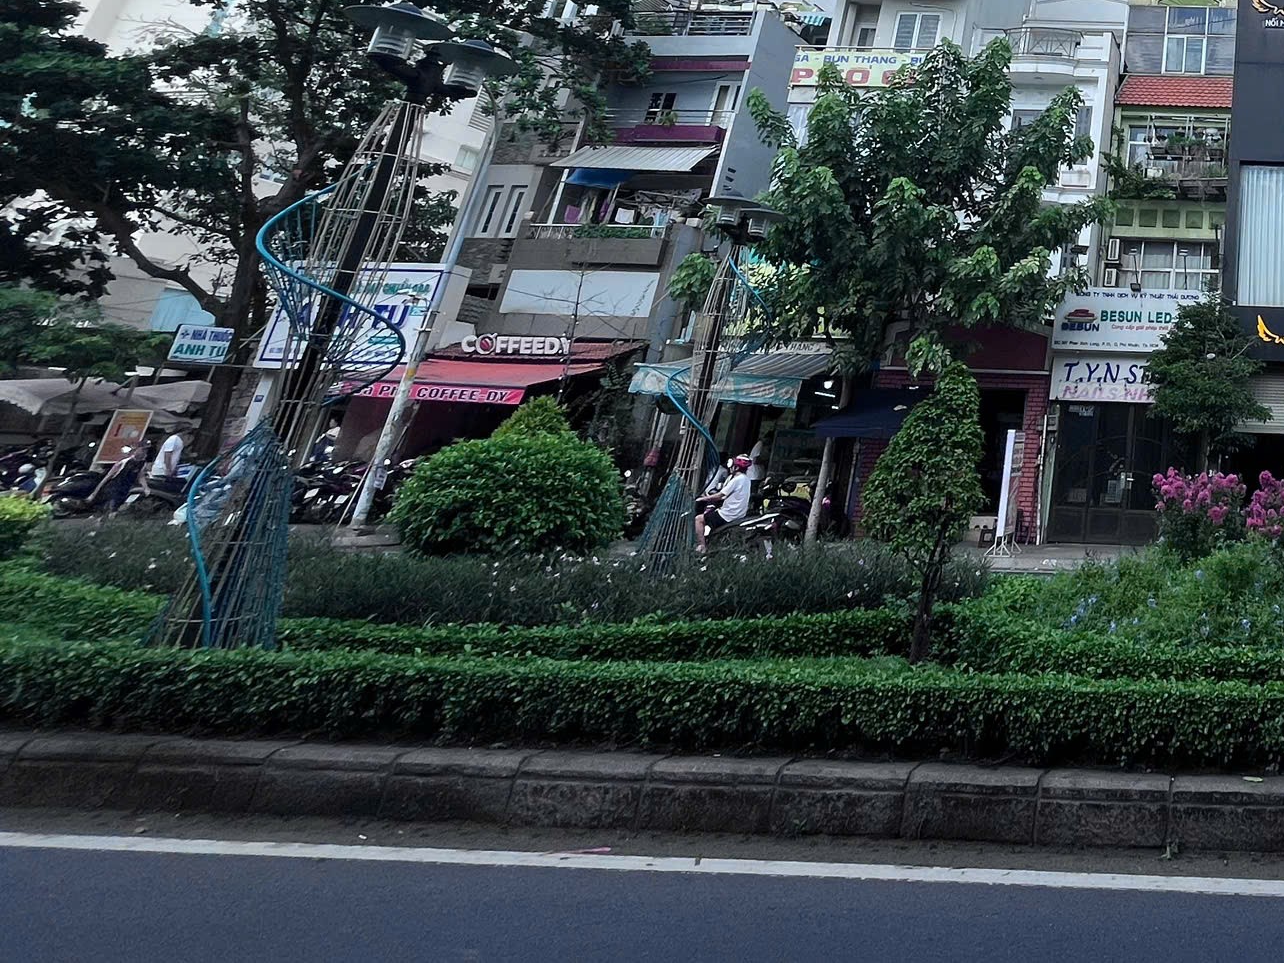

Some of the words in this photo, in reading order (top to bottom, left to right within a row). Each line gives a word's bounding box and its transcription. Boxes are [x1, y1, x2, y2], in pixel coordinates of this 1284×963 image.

[1100, 310, 1142, 323] BESUN
[1147, 311, 1173, 324] LED
[173, 344, 206, 356] ANH
[209, 343, 227, 356] TÚ
[417, 386, 507, 402] COFFEE-DY
